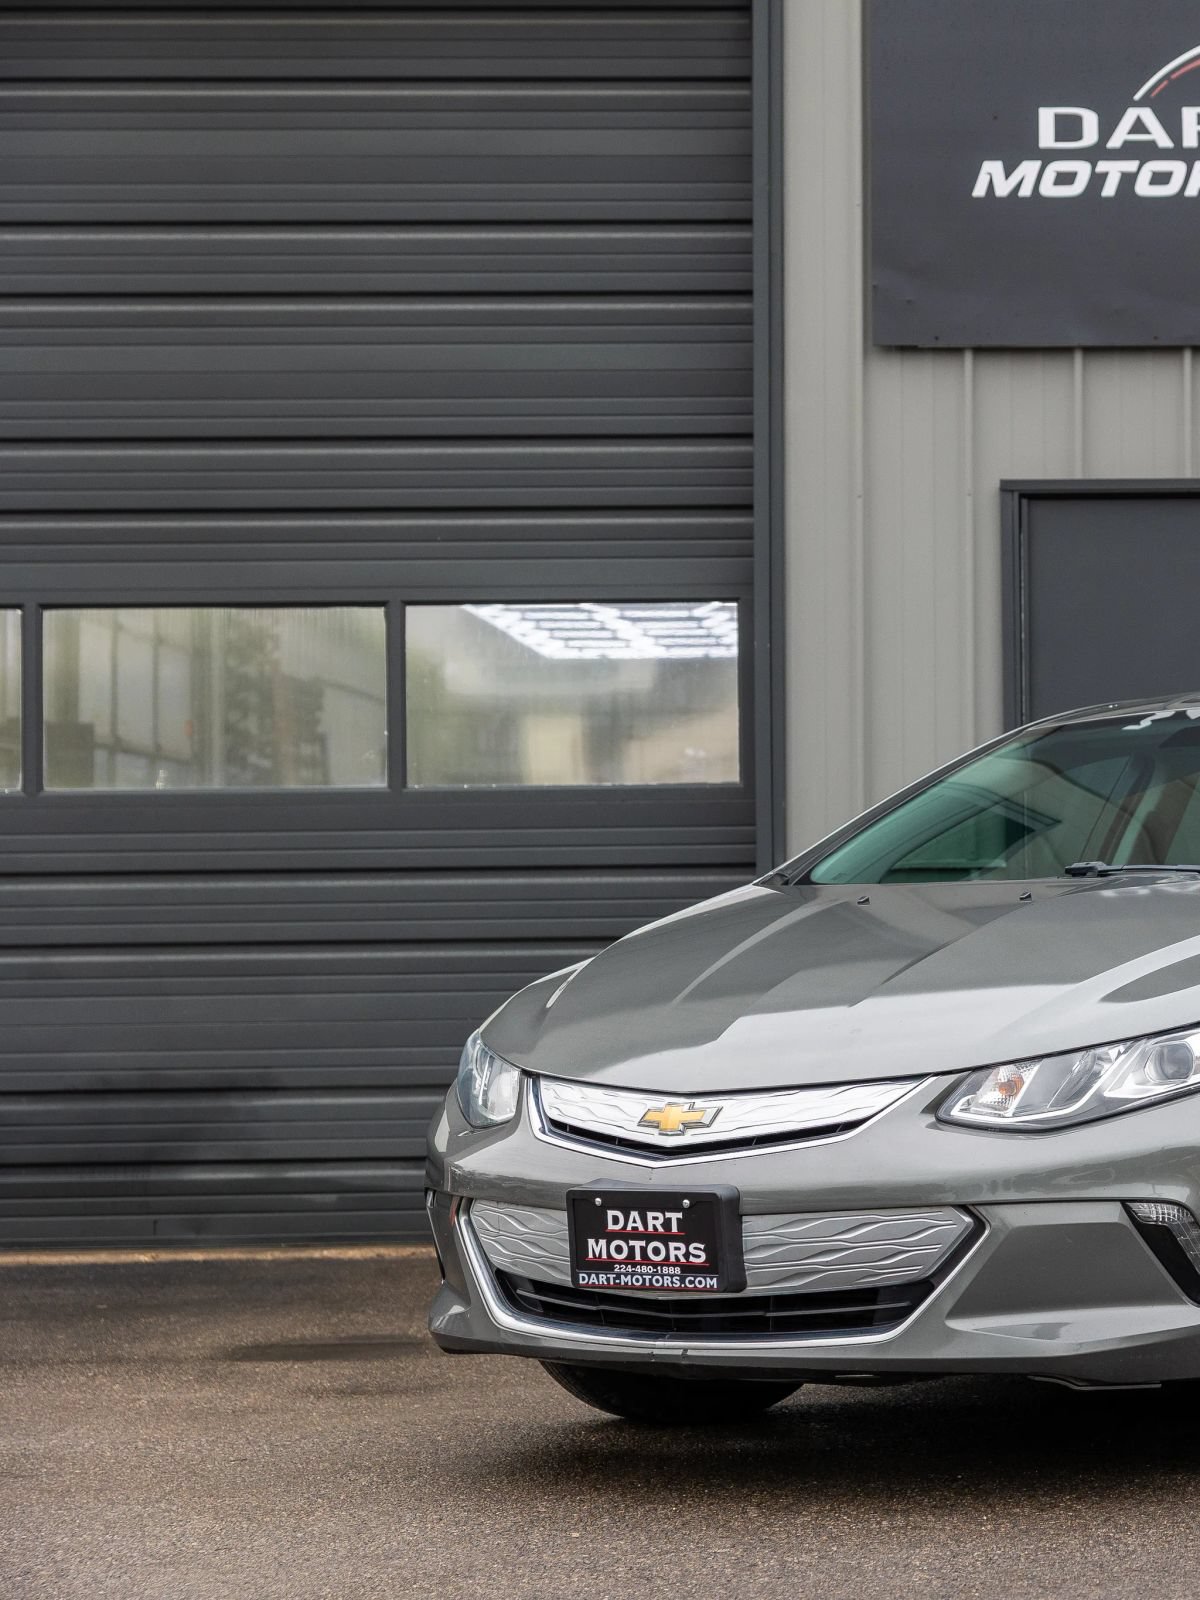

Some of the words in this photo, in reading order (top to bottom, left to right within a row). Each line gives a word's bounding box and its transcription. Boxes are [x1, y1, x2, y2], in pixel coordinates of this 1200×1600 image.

[606, 1209, 683, 1232] DART
[587, 1238, 707, 1263] MOTORS
[613, 1264, 681, 1275] 224-480-1888
[578, 1273, 718, 1289] DART-MOTORS.COM
